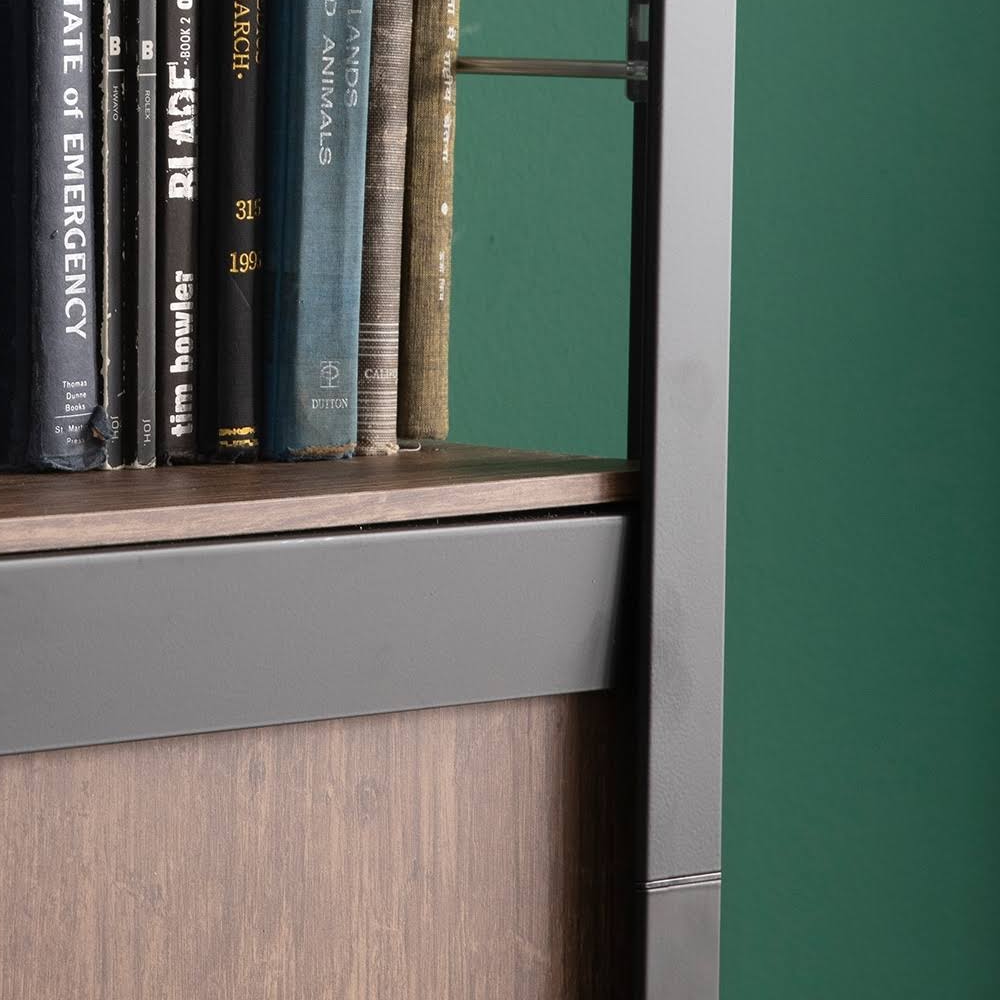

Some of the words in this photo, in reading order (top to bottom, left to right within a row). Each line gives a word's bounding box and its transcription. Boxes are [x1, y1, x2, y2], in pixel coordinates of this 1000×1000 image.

[180, 17, 191, 25] 2
[109, 35, 121, 56] B
[142, 40, 154, 60] B
[180, 28, 191, 59] BOOK
[344, 8, 363, 108] LANDS
[63, 87, 84, 120] of
[318, 33, 338, 166] ANIMALS
[63, 132, 88, 340] EMERGENCY
[169, 270, 194, 374] bowler
[62, 380, 87, 389] Thomas
[66, 391, 87, 400] Dunne
[65, 403, 86, 412] Books
[170, 383, 193, 438] tim
[312, 398, 349, 409] DUTTON
